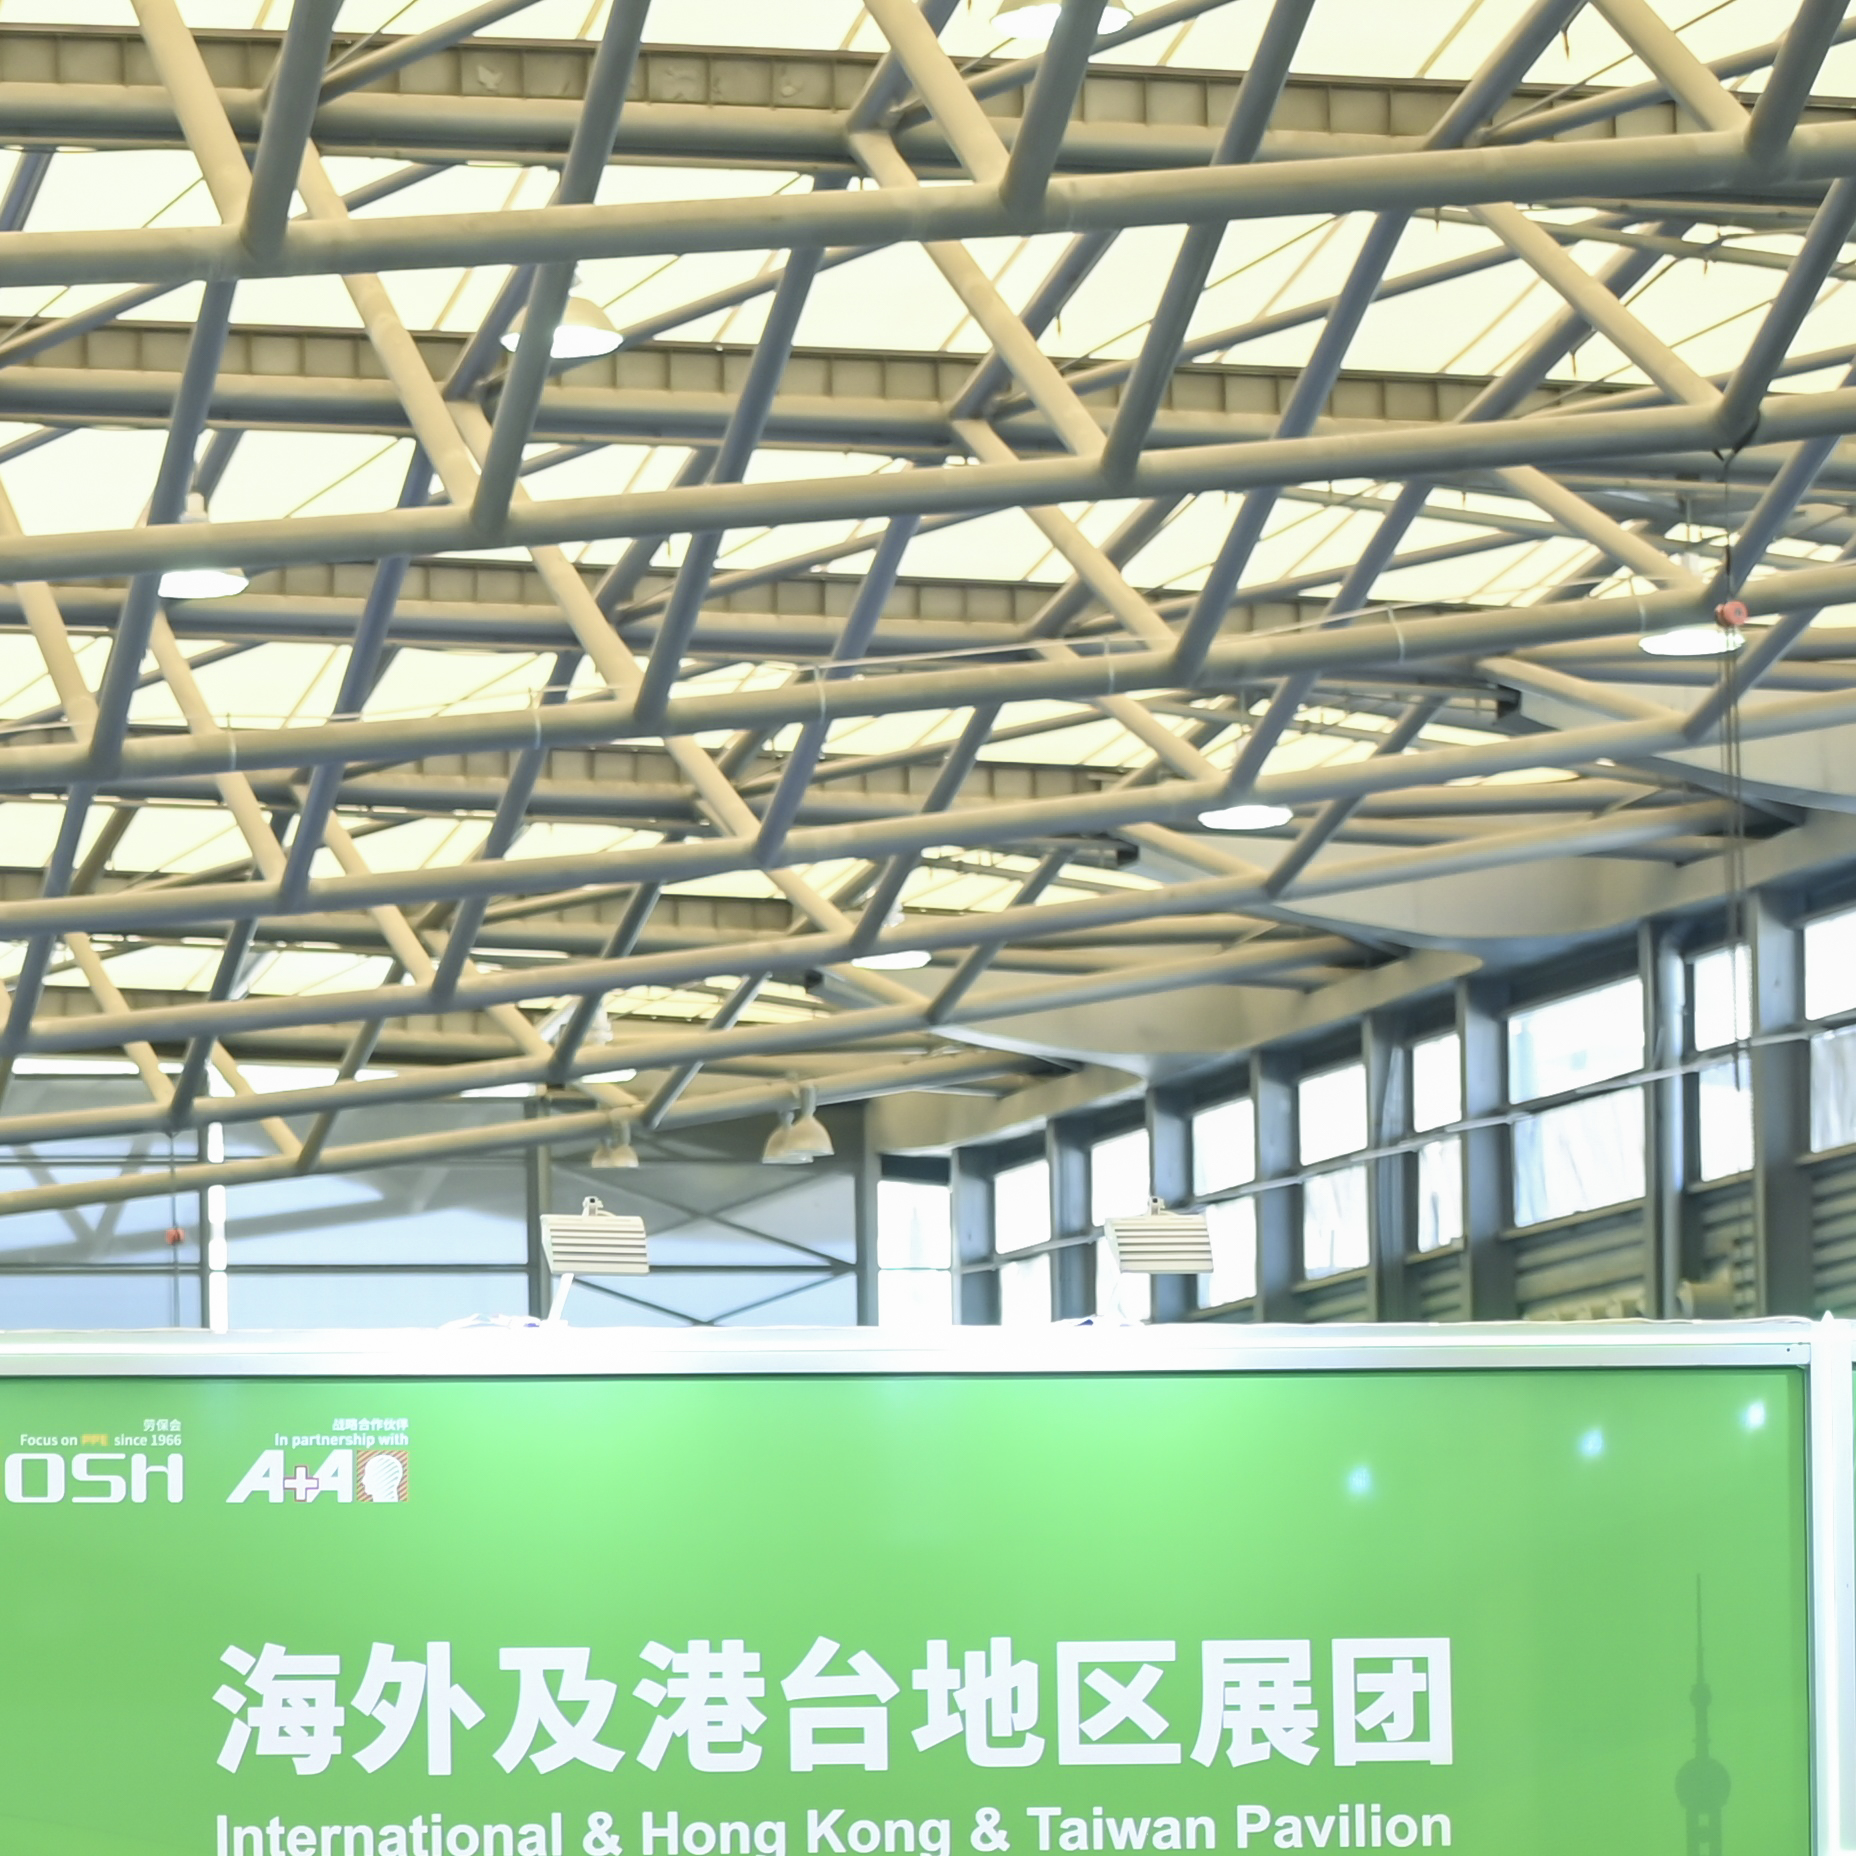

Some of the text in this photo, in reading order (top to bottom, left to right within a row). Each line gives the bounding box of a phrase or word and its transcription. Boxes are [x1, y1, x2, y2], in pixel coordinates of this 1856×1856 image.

[20, 1434, 59, 1446] Focus
[62, 1437, 78, 1446] on
[114, 1433, 146, 1446] since
[150, 1434, 182, 1446] 1966
[275, 1433, 409, 1449] In partnership with
[212, 1636, 1454, 1776] 海外及港台地区展团
[582, 1811, 622, 1856] &
[970, 1807, 1010, 1852] &
[1027, 1806, 1216, 1851] Taiwan
[1236, 1803, 1453, 1849] Pavilion
